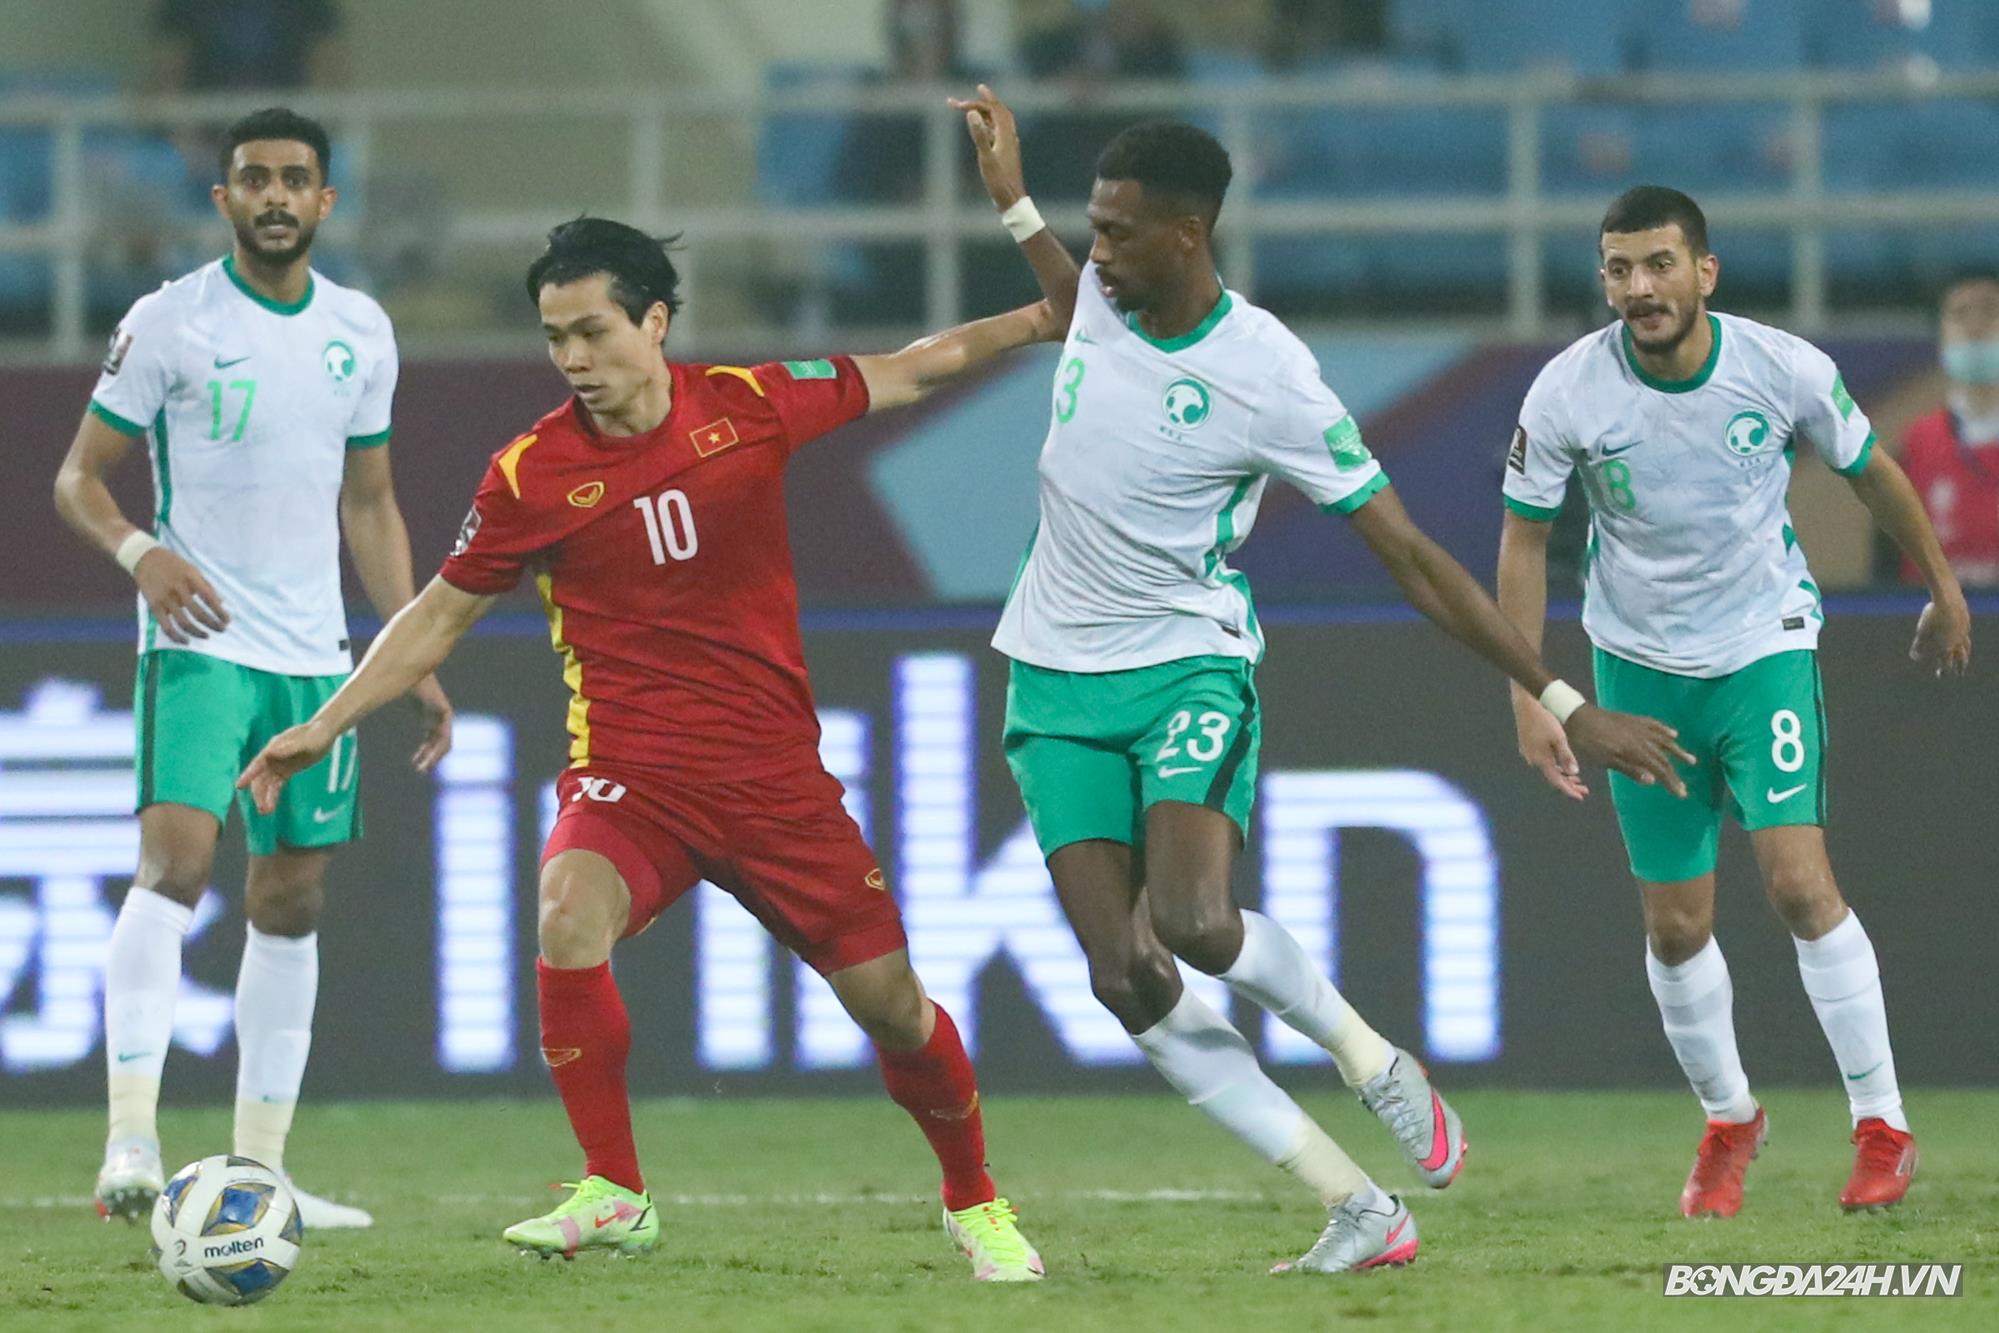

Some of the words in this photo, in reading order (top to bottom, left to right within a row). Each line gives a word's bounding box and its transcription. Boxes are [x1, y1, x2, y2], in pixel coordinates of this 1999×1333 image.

[206, 379, 257, 442] 17
[1054, 357, 1086, 424] 3
[1603, 459, 1636, 513] 8
[633, 488, 699, 566] 10
[1155, 710, 1231, 762] 23
[1770, 709, 1805, 773] 8
[571, 776, 627, 803] 10
[204, 1237, 264, 1258] molten
